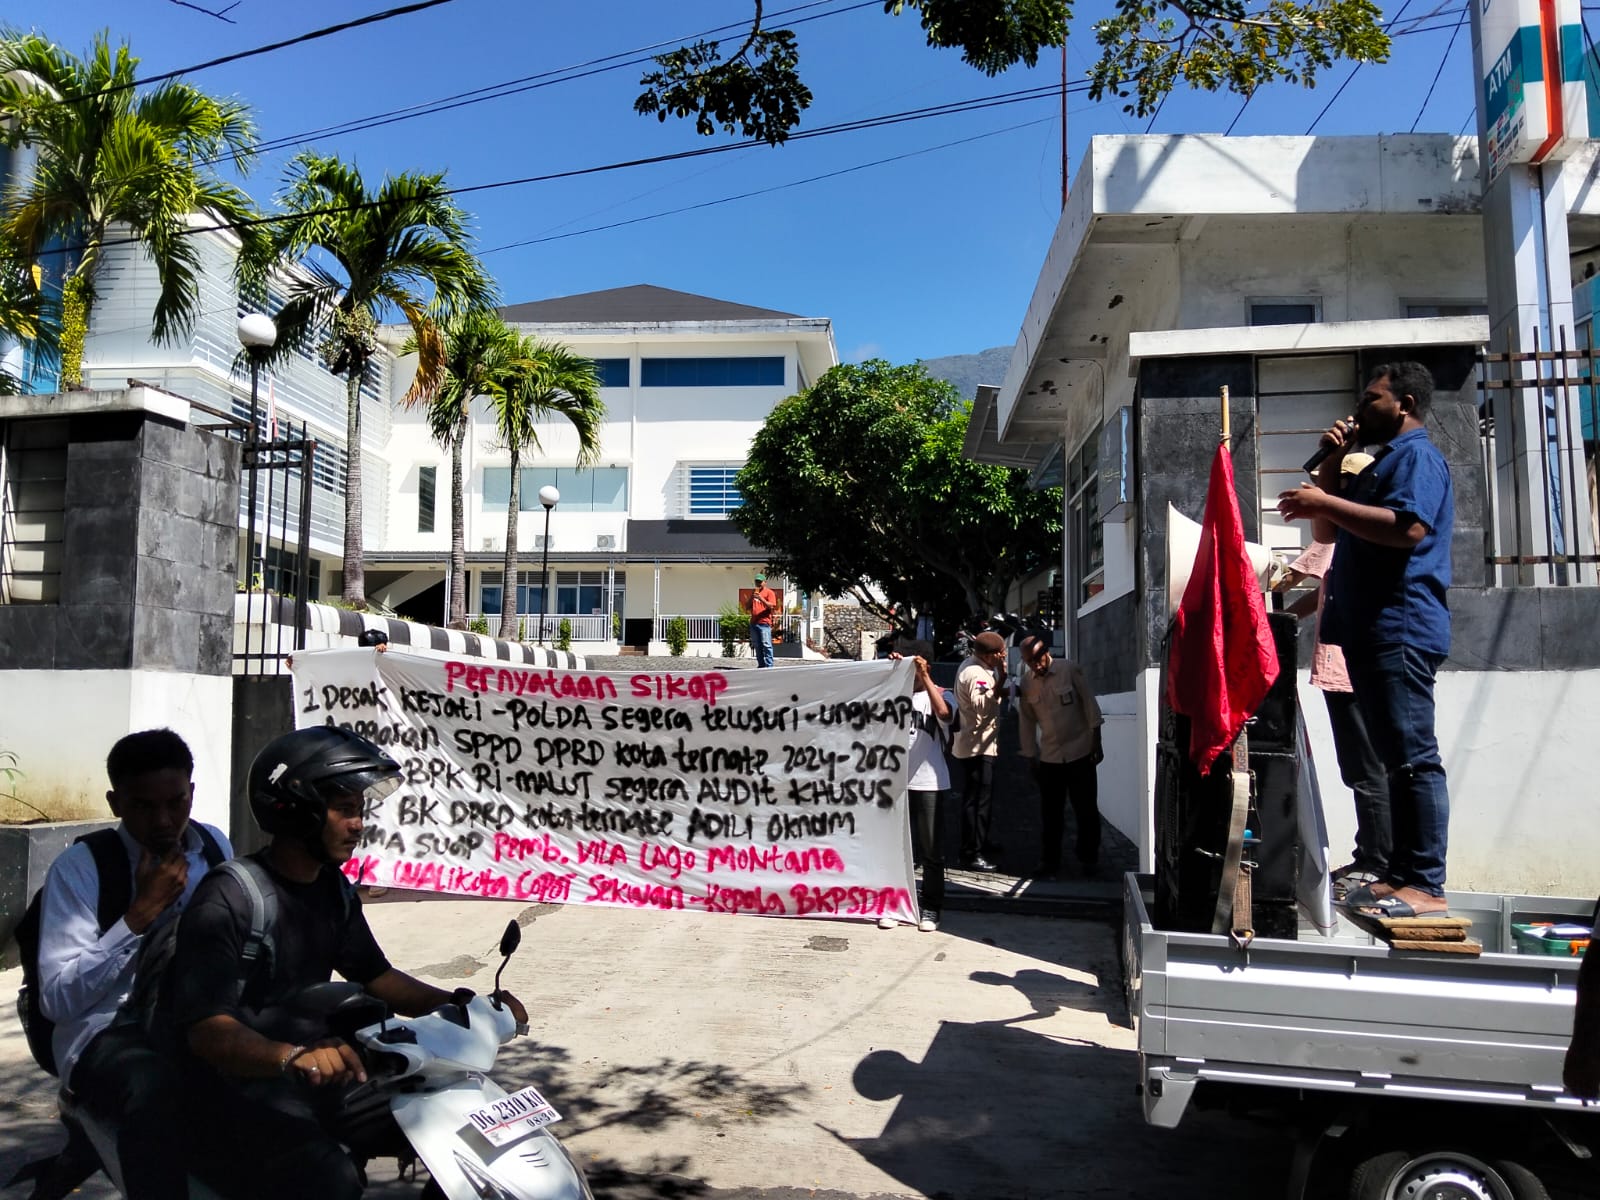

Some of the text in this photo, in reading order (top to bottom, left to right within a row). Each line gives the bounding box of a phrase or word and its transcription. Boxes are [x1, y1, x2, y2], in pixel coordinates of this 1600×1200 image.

[1488, 47, 1512, 101] ATM
[454, 729, 522, 759] SPPD
[533, 737, 605, 768] DPRD
[404, 757, 465, 789] BPK
[398, 795, 440, 826] BK
[492, 1096, 528, 1120] 2310
